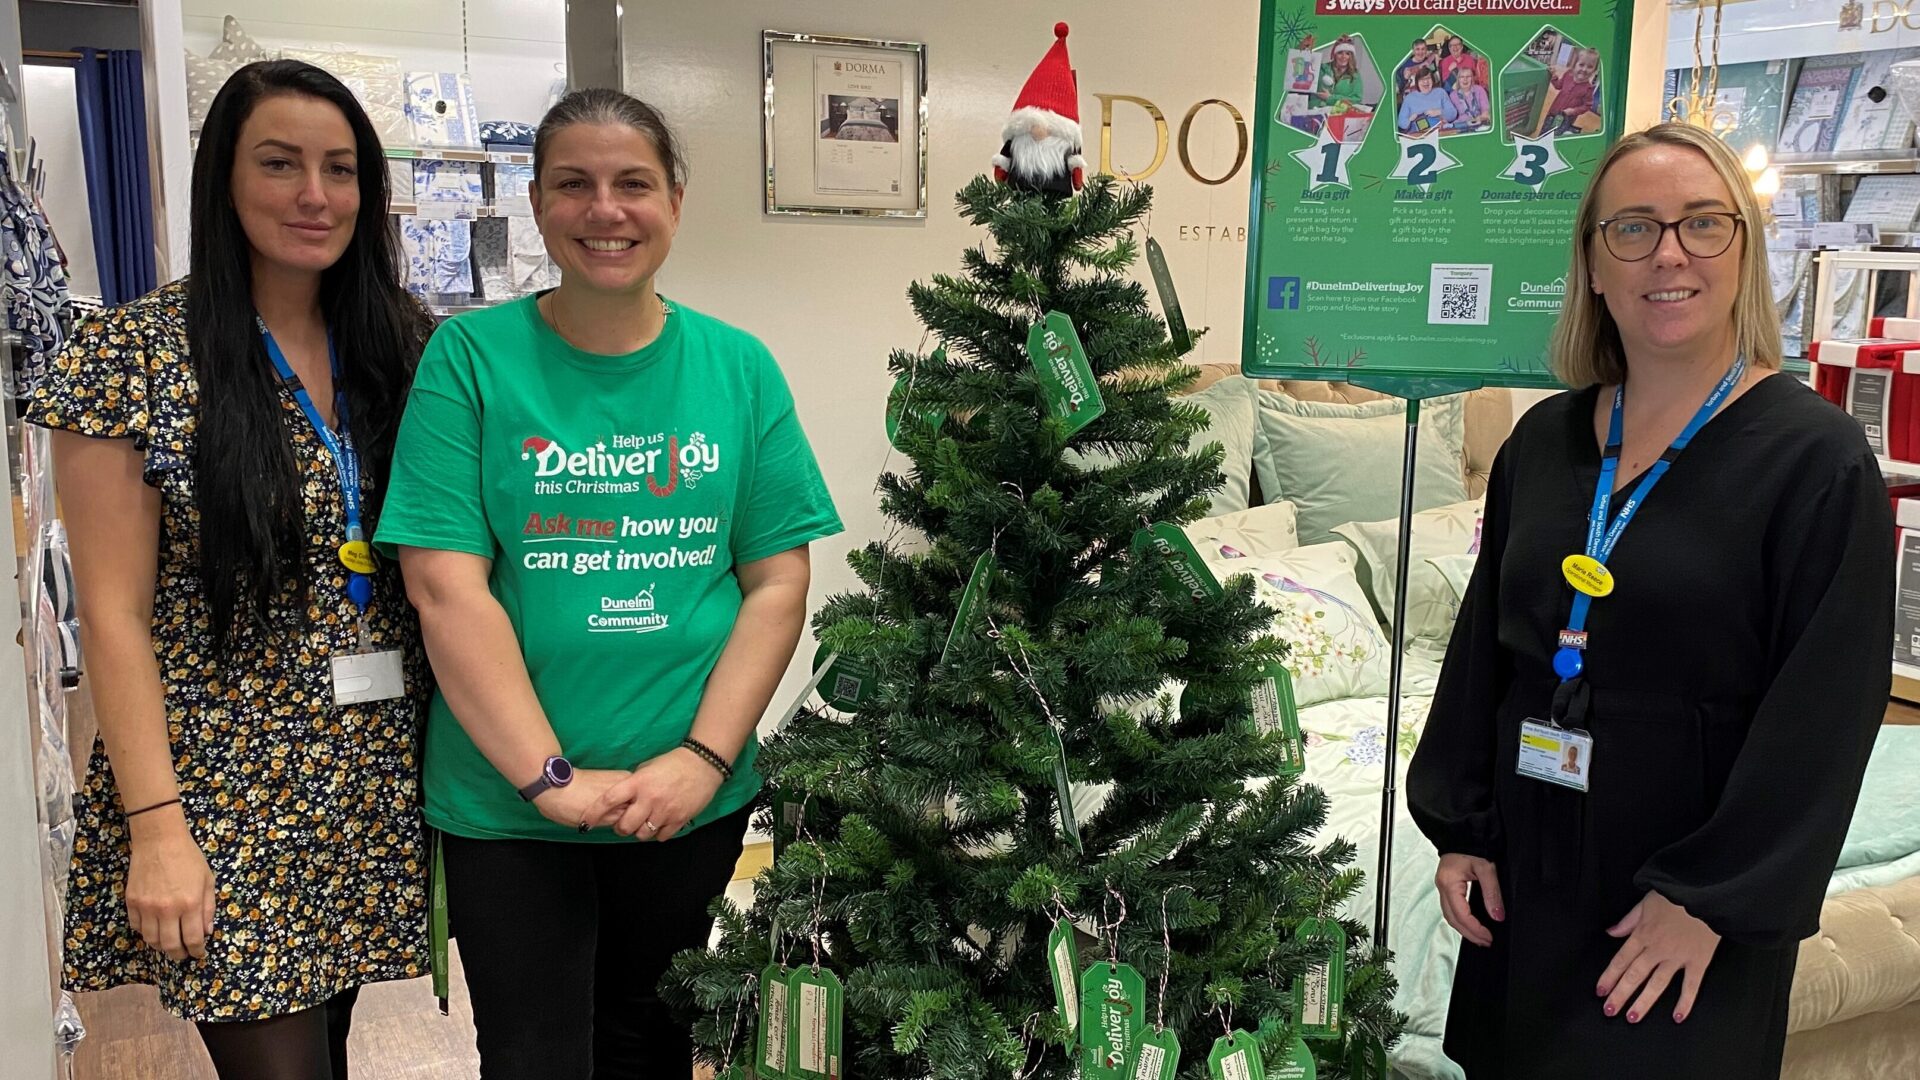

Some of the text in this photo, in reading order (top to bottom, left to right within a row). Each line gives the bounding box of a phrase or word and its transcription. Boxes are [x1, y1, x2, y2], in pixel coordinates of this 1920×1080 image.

[1339, 0, 1385, 12] ways
[1388, 0, 1420, 12] you
[1423, 0, 1454, 10] can
[1457, 0, 1483, 12] get
[845, 62, 886, 75] DORMA
[1092, 93, 1249, 186] DO
[1315, 143, 1342, 183] 1
[1406, 144, 1438, 186] 2
[1514, 145, 1549, 187] 3
[1301, 189, 1351, 201] Buy a gift
[1394, 189, 1453, 201] Make a gift
[1481, 189, 1583, 202] Donate spare decs
[1293, 206, 1308, 214] Pick
[1330, 206, 1342, 214] find
[1392, 206, 1407, 215] Pick
[1430, 206, 1447, 215] craft
[1483, 207, 1568, 217] Drop your decorations
[1286, 216, 1313, 225] present
[1314, 216, 1328, 224] and
[1389, 216, 1401, 225] gift
[1402, 216, 1417, 225] and
[1449, 217, 1456, 225] in
[1538, 219, 1556, 227] pass
[1302, 226, 1315, 234] gift
[1316, 226, 1329, 235] bag
[1331, 226, 1341, 235] by
[1398, 226, 1411, 235] gift
[1412, 226, 1426, 236] bag
[1428, 226, 1438, 236] by
[1439, 226, 1451, 234] the
[1513, 227, 1531, 235] local
[1533, 228, 1555, 236] space
[1293, 234, 1309, 242] date
[1392, 235, 1409, 243] date
[1510, 237, 1554, 246] brightening
[1306, 281, 1424, 294] #DunelmDeliveringJoy
[1520, 281, 1564, 293] Dunelm
[1307, 294, 1325, 302] Scan
[1326, 294, 1342, 302] here
[1352, 295, 1365, 304] join
[1307, 304, 1328, 313] group
[1345, 304, 1366, 312] follow
[1381, 305, 1400, 314] story
[1397, 334, 1409, 342] See
[1054, 356, 1085, 406] Deliver
[612, 432, 665, 450] Help us
[534, 434, 719, 498] Deliver Joy
[534, 480, 640, 495] this Christmas
[346, 489, 356, 510] NHS
[1598, 494, 1609, 510] Torbay
[1620, 499, 1637, 519] NHS
[522, 512, 719, 539] Ask me how you
[1595, 521, 1603, 538] South
[1591, 538, 1601, 557] Devon
[523, 544, 717, 576] can get involved!
[1169, 559, 1208, 600] Deliver
[600, 595, 652, 609] Dunelm
[587, 613, 670, 628] Community
[1561, 633, 1584, 645] NHS
[1101, 1003, 1107, 1013] us
[1104, 978, 1134, 1066] Deliver Joy
